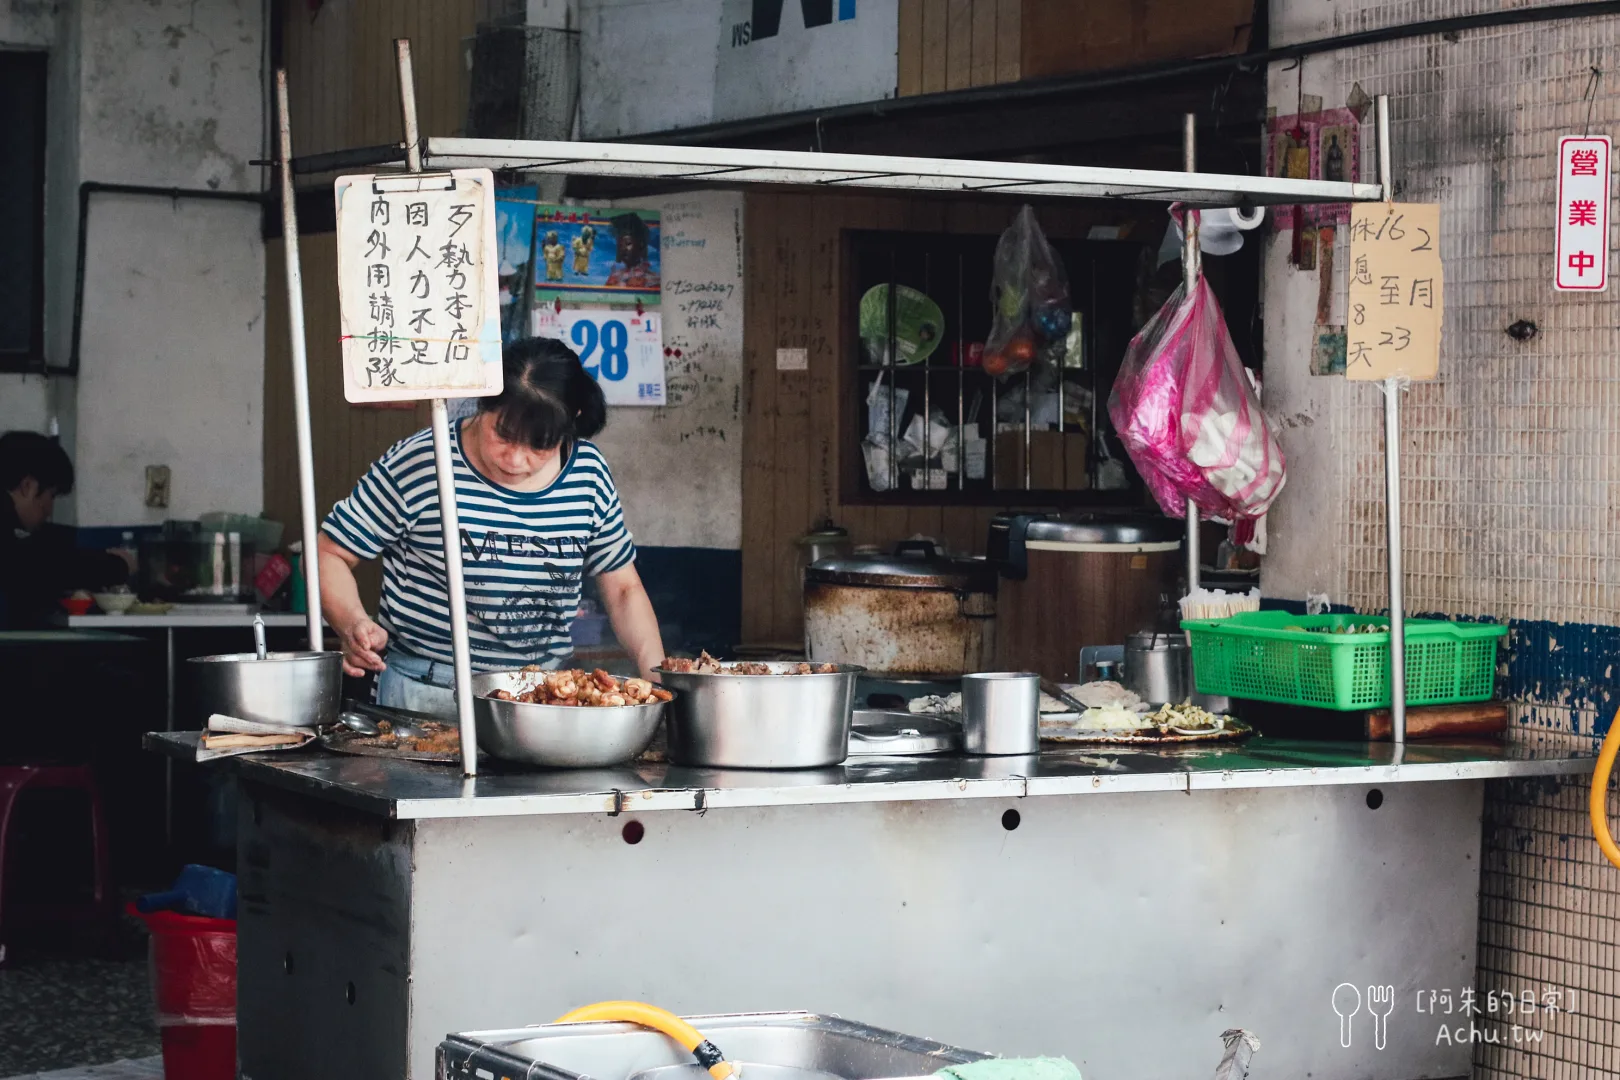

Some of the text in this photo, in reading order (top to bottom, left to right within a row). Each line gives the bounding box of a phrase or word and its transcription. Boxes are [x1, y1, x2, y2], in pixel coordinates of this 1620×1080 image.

[1568, 149, 1598, 277] 營業中
[401, 201, 438, 365] 因人力不足
[1409, 227, 1433, 309] 2月
[571, 319, 629, 382] 28
